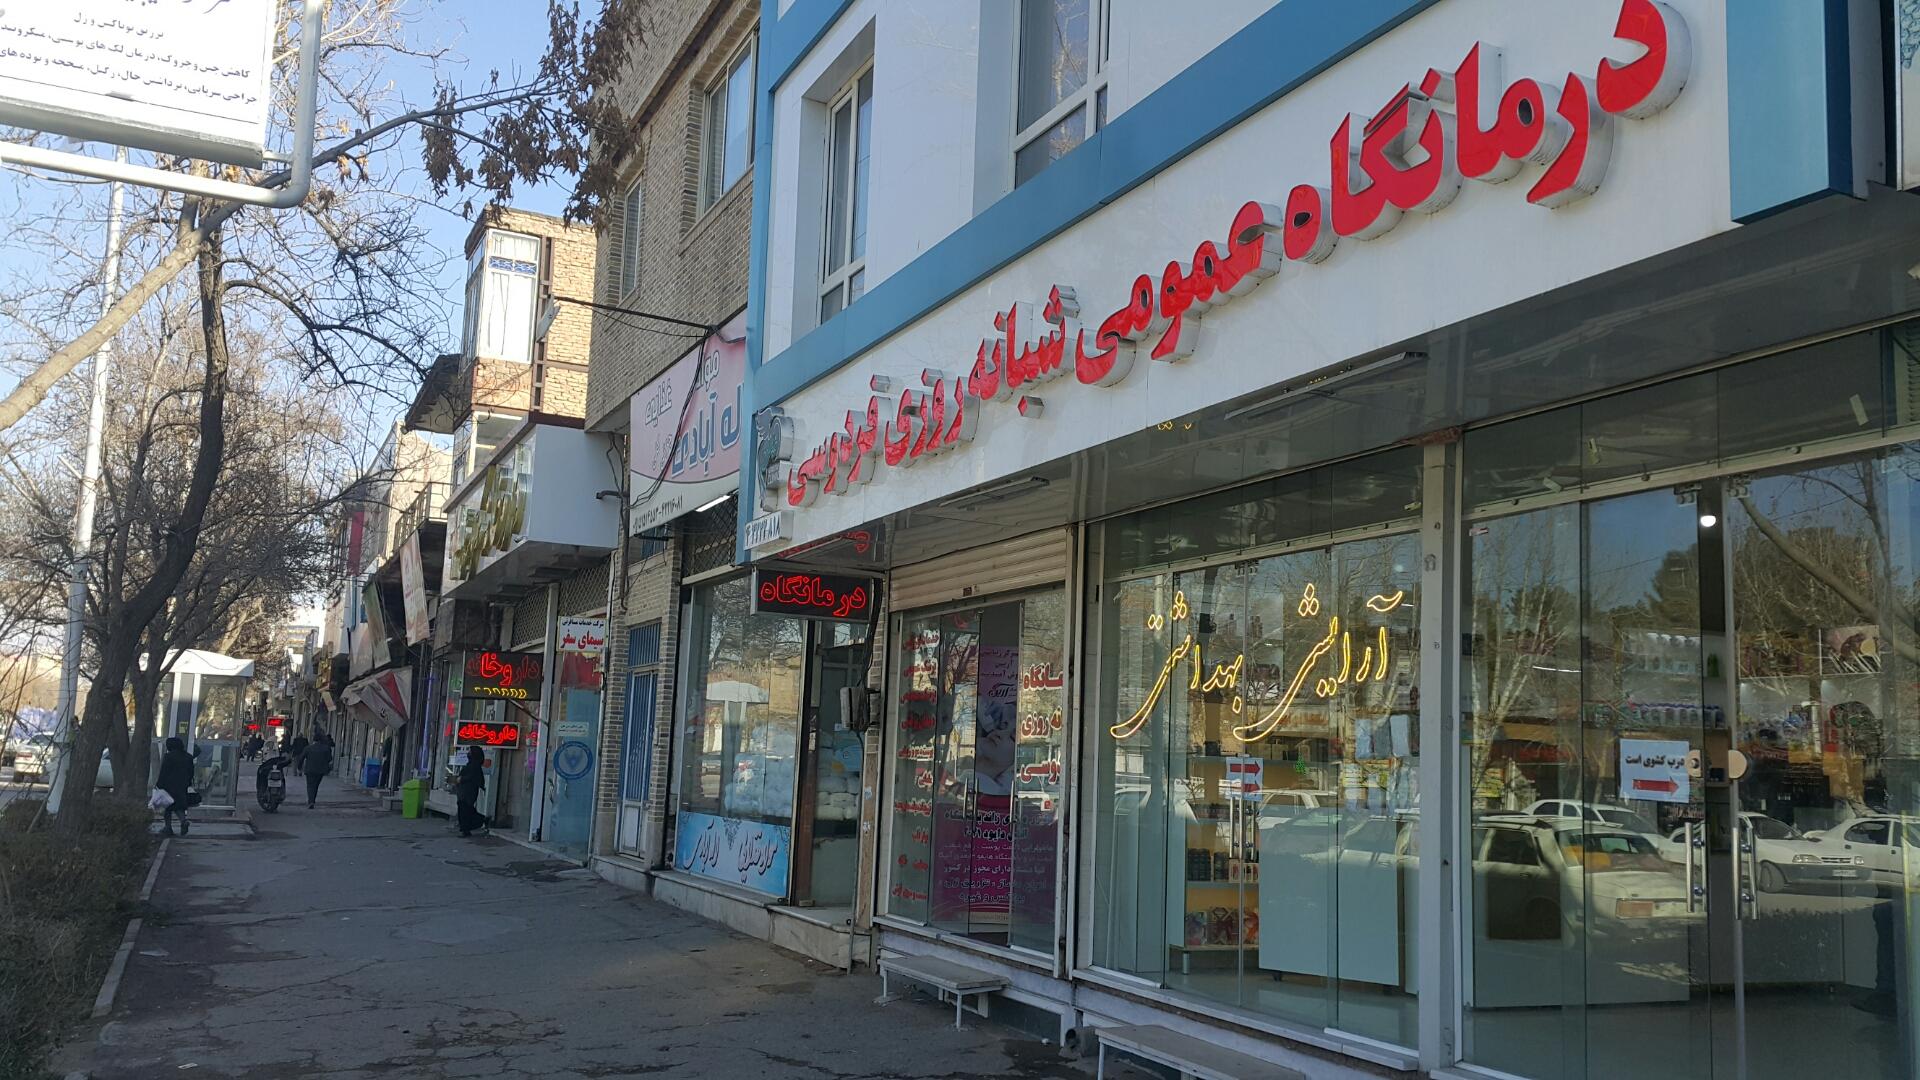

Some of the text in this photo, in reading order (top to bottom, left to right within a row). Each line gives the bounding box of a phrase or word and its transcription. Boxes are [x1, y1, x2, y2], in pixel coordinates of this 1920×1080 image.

[86, 40, 106, 50] های
[108, 44, 124, 53] لک
[125, 47, 156, 61] درمان
[220, 66, 251, 78] کاهش
[222, 92, 258, 105] جراحی
[787, 0, 1684, 508] درمانگاه عمومی شبانه روزی فردوسی
[760, 575, 867, 617] درمانگاه
[560, 629, 604, 650] سیمای سفر
[466, 651, 540, 686] داروخانه
[1021, 712, 1050, 737] روزی
[459, 723, 518, 744] داروخانه
[1625, 754, 1642, 764] است
[1667, 757, 1685, 769] درب
